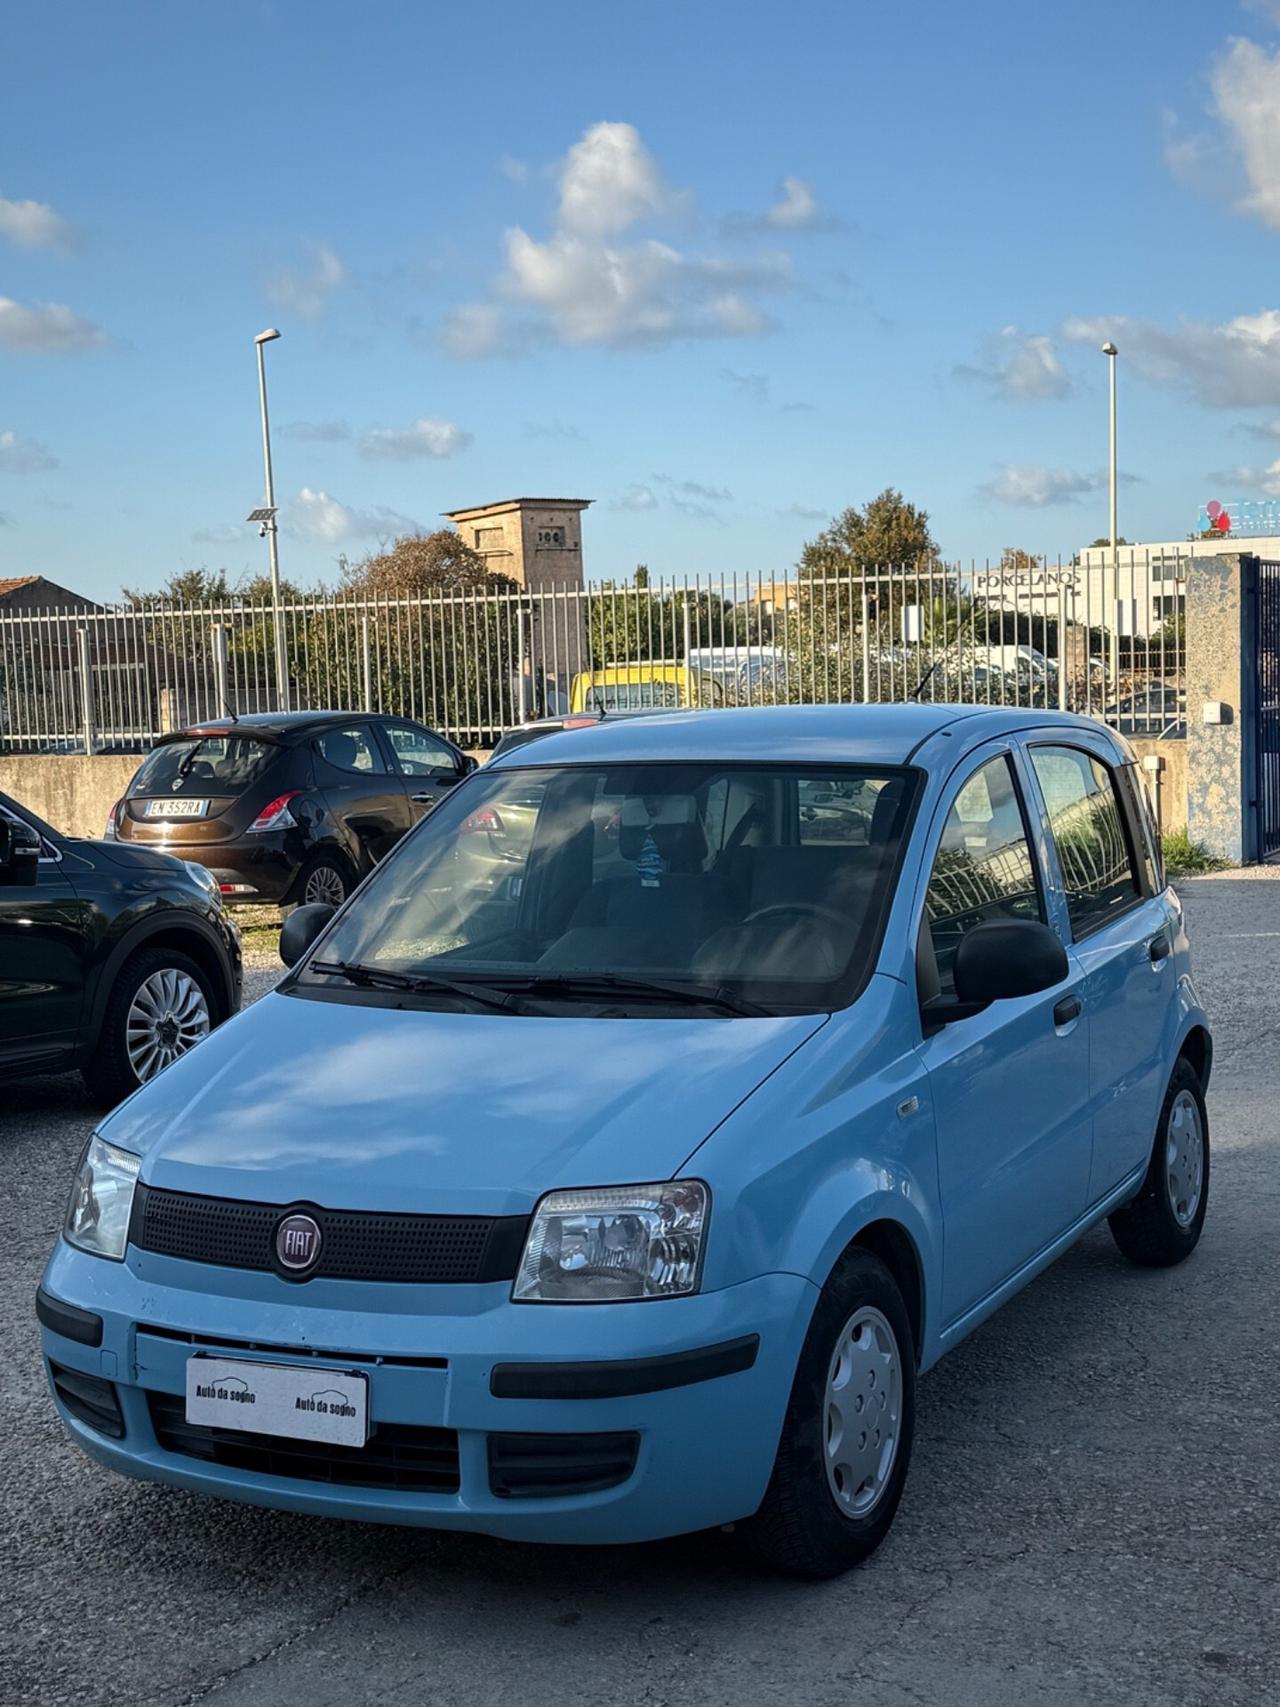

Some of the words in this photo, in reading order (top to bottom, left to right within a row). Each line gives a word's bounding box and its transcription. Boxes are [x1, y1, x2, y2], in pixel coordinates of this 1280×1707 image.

[285, 1230, 312, 1256] FIAT
[196, 1385, 216, 1399] Auto
[217, 1387, 228, 1400] da
[229, 1390, 256, 1404] sogno
[295, 1397, 315, 1411] Auto
[316, 1400, 328, 1413] da
[329, 1403, 356, 1417] sogno
